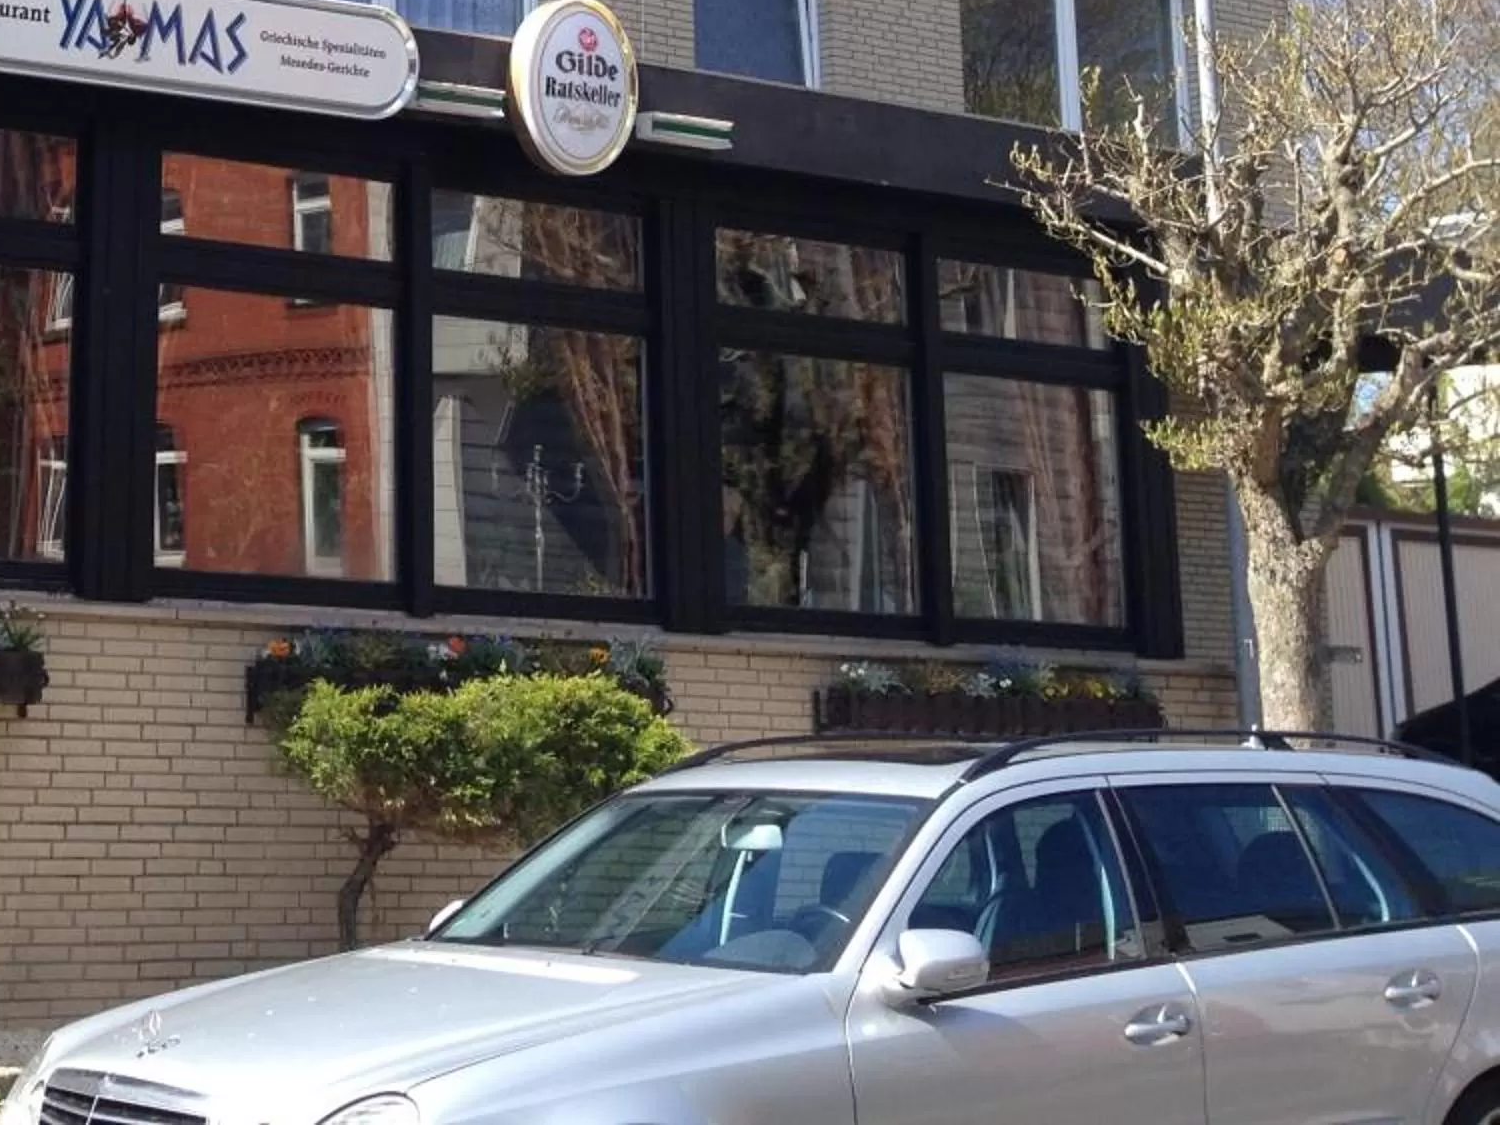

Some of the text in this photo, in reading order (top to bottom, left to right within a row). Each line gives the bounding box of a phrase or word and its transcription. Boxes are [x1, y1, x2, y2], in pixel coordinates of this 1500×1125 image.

[259, 30, 320, 51] Griechische
[555, 50, 619, 82] Gilde
[544, 76, 622, 108] Ratskeller
